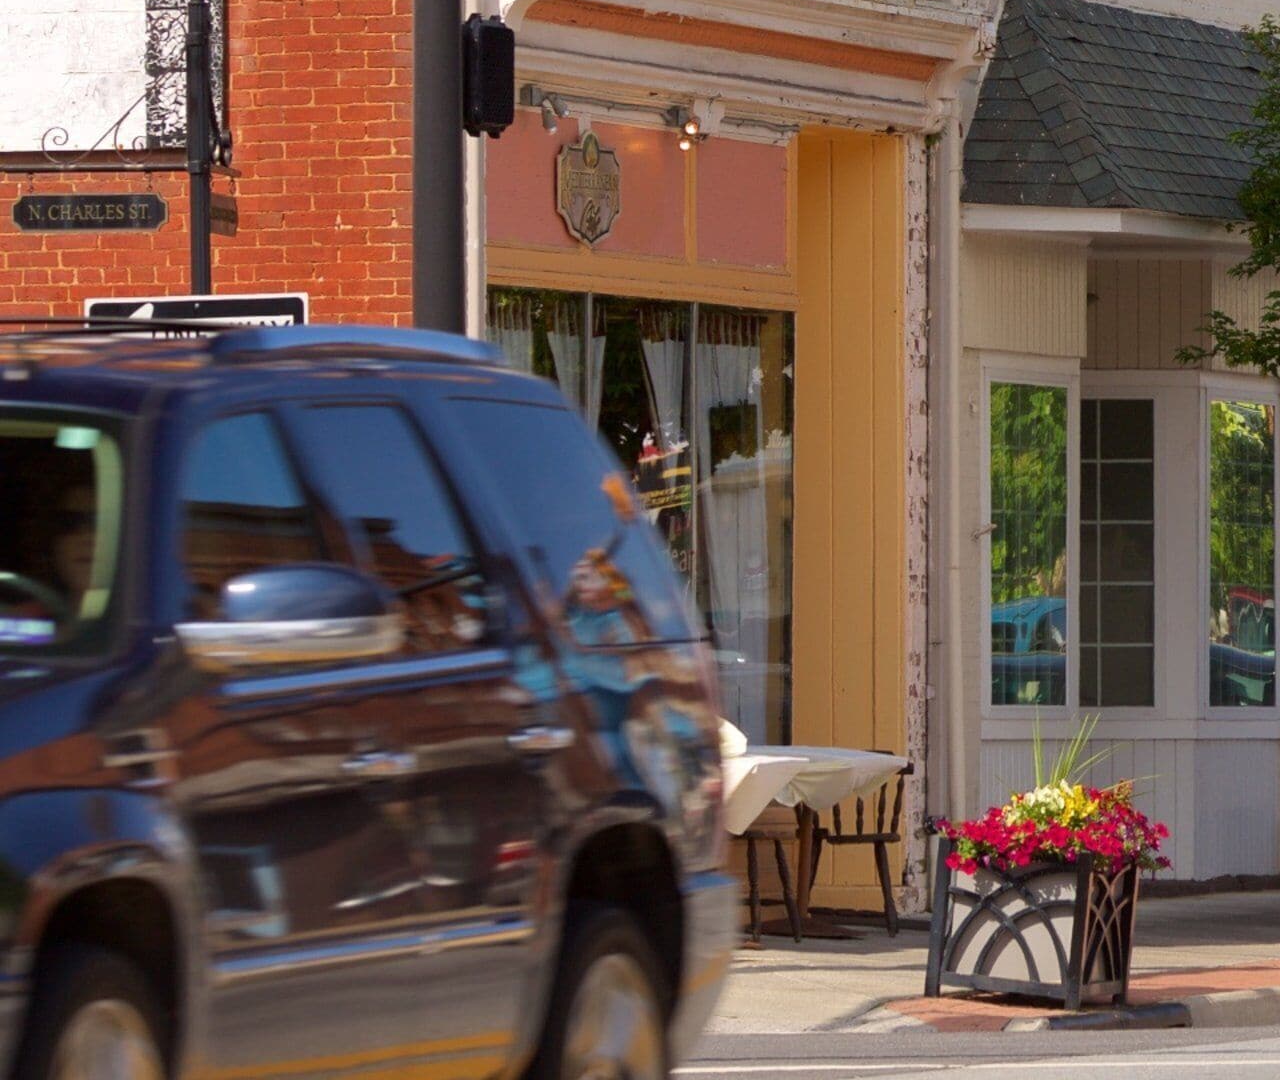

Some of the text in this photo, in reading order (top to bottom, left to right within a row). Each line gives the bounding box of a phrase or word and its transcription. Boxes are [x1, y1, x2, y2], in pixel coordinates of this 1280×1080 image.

[28, 204, 151, 220] N. CHARLES ST.
